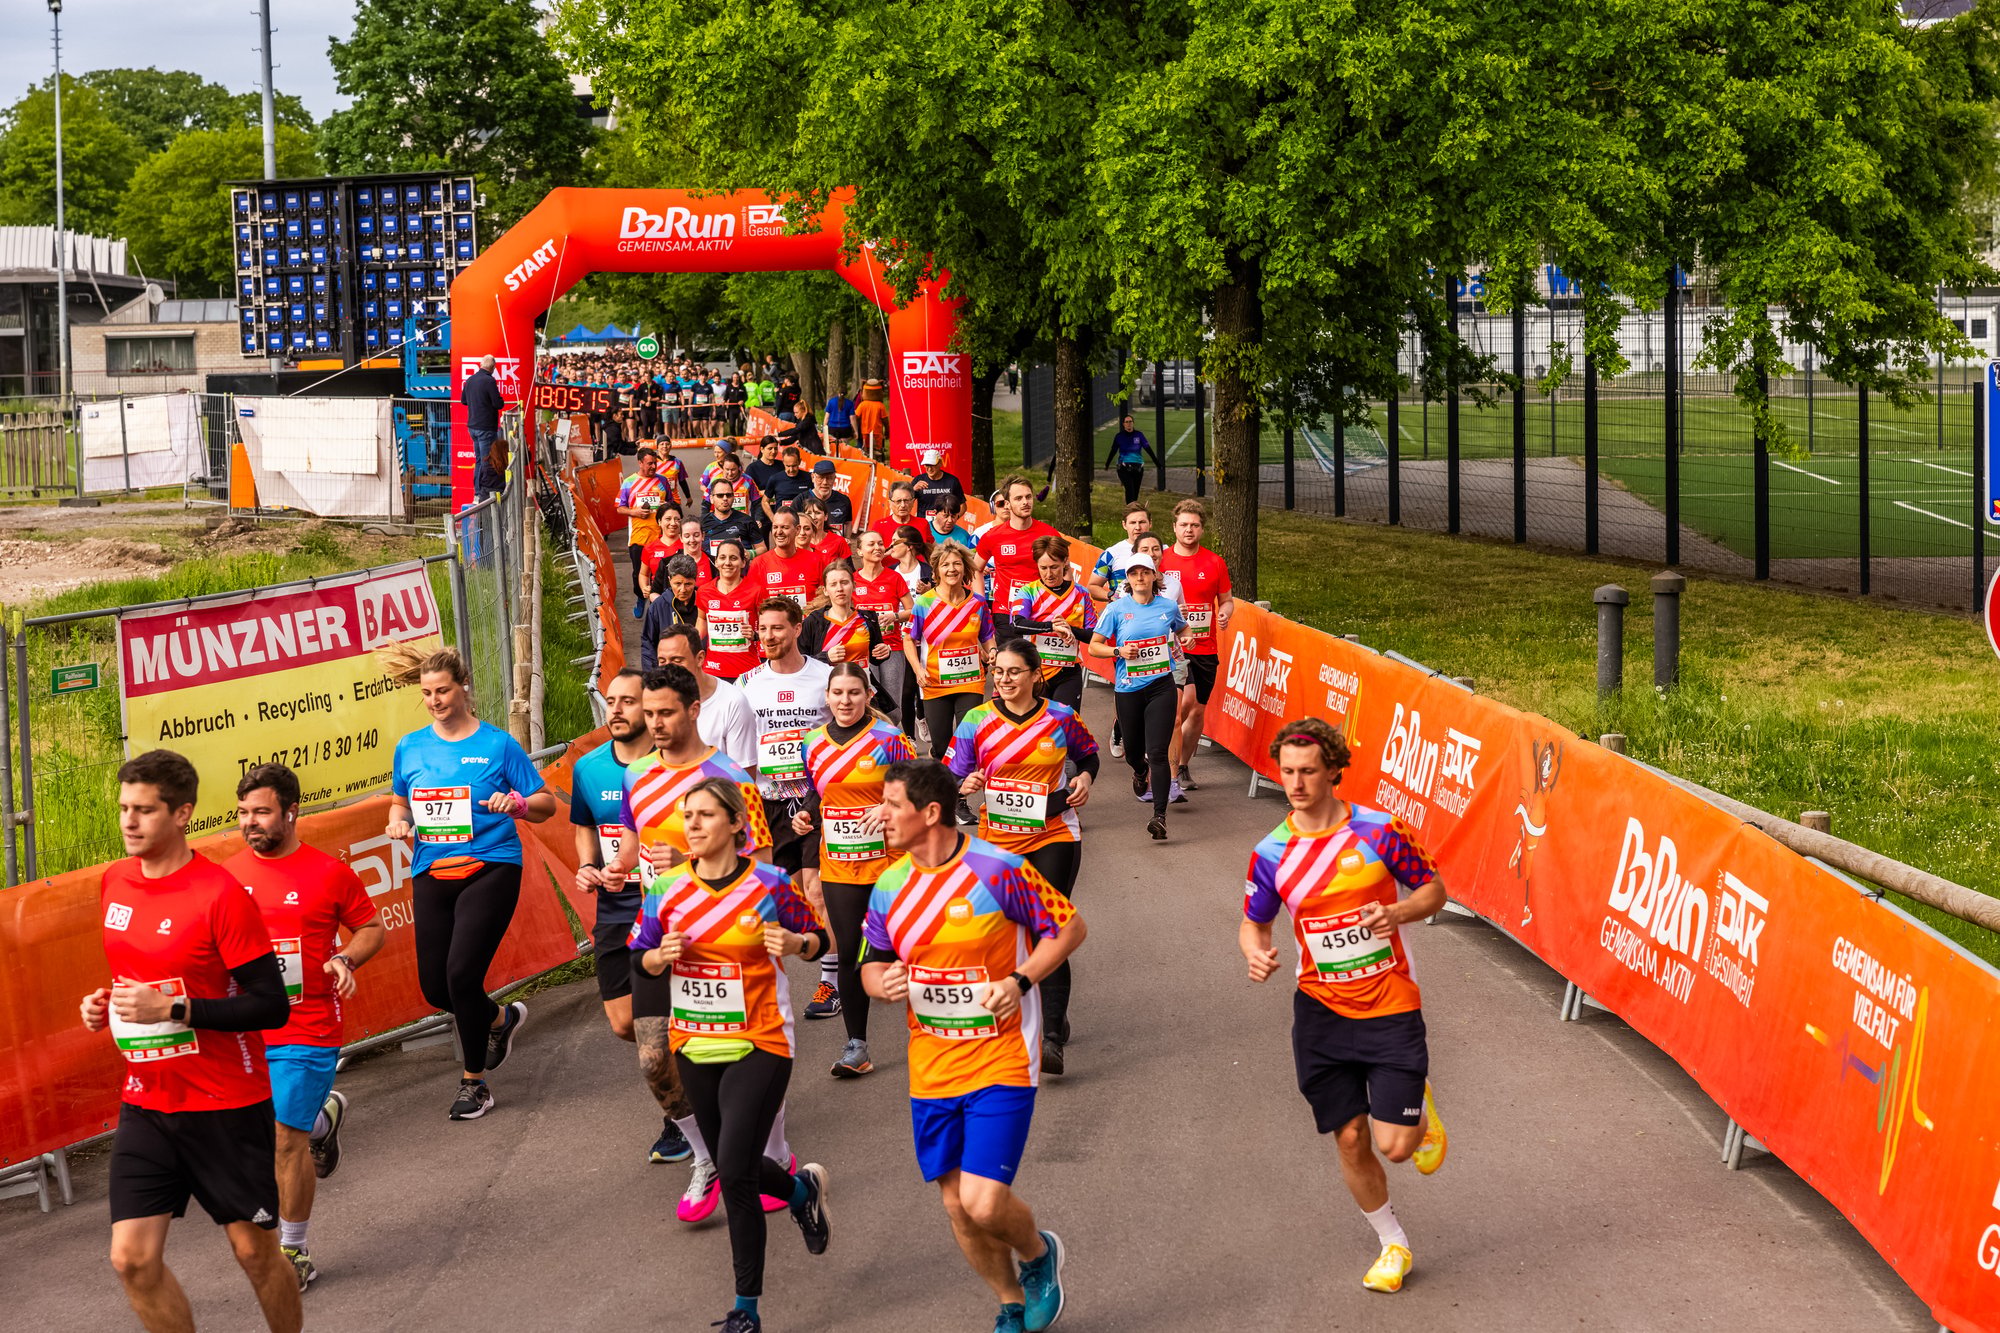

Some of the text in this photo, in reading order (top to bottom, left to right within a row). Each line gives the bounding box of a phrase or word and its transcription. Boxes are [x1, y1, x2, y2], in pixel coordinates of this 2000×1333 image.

[620, 207, 736, 239] B2Run
[748, 205, 789, 224] DA
[749, 224, 783, 237] Gesun
[503, 239, 557, 292] START
[640, 343, 655, 352] GO
[903, 351, 960, 374] DAK
[904, 375, 961, 388] Gesundheit
[535, 386, 610, 412] 18:05:15
[1002, 545, 1015, 554] DB
[768, 573, 781, 583] DB
[714, 624, 739, 632] 4735
[1188, 613, 1206, 621] 615
[130, 586, 430, 685] MÜNZNER BAU
[947, 656, 972, 667] 4541
[1137, 646, 1160, 658] 662
[1226, 631, 1265, 704] B2Run
[1266, 647, 1293, 694] DAK
[1319, 664, 1359, 696] GEMEINSAM FÜR
[779, 692, 793, 701] DB
[1326, 689, 1349, 715] VIELFALT
[159, 709, 235, 741] Abbruch
[258, 692, 332, 723] Recycling
[756, 707, 817, 718] Wir machen
[768, 719, 806, 729] Strecke
[293, 745, 308, 768] 21
[323, 740, 330, 761] 8
[335, 736, 351, 758] 30
[356, 728, 378, 753] 140
[1381, 702, 1438, 798] B2Run
[1442, 727, 1481, 789] DAK
[461, 756, 489, 764] grenke
[345, 771, 393, 793] www.muen
[601, 791, 622, 800] SIE
[996, 793, 1034, 808] 4530
[425, 802, 452, 815] 977
[833, 821, 861, 834] 452
[350, 827, 414, 898] DA
[1608, 817, 1709, 963] B2Run
[105, 904, 131, 928] DB
[1704, 869, 1724, 971] powered by
[1716, 871, 1769, 967] DAK
[1322, 926, 1372, 949] 4560
[1709, 938, 1755, 1008] Gesundheit
[1832, 936, 1917, 1021] GEMEINSAM FÜR
[681, 980, 727, 998] 4516
[923, 987, 973, 1004] 4559
[1853, 990, 1899, 1050] VIELFALT
